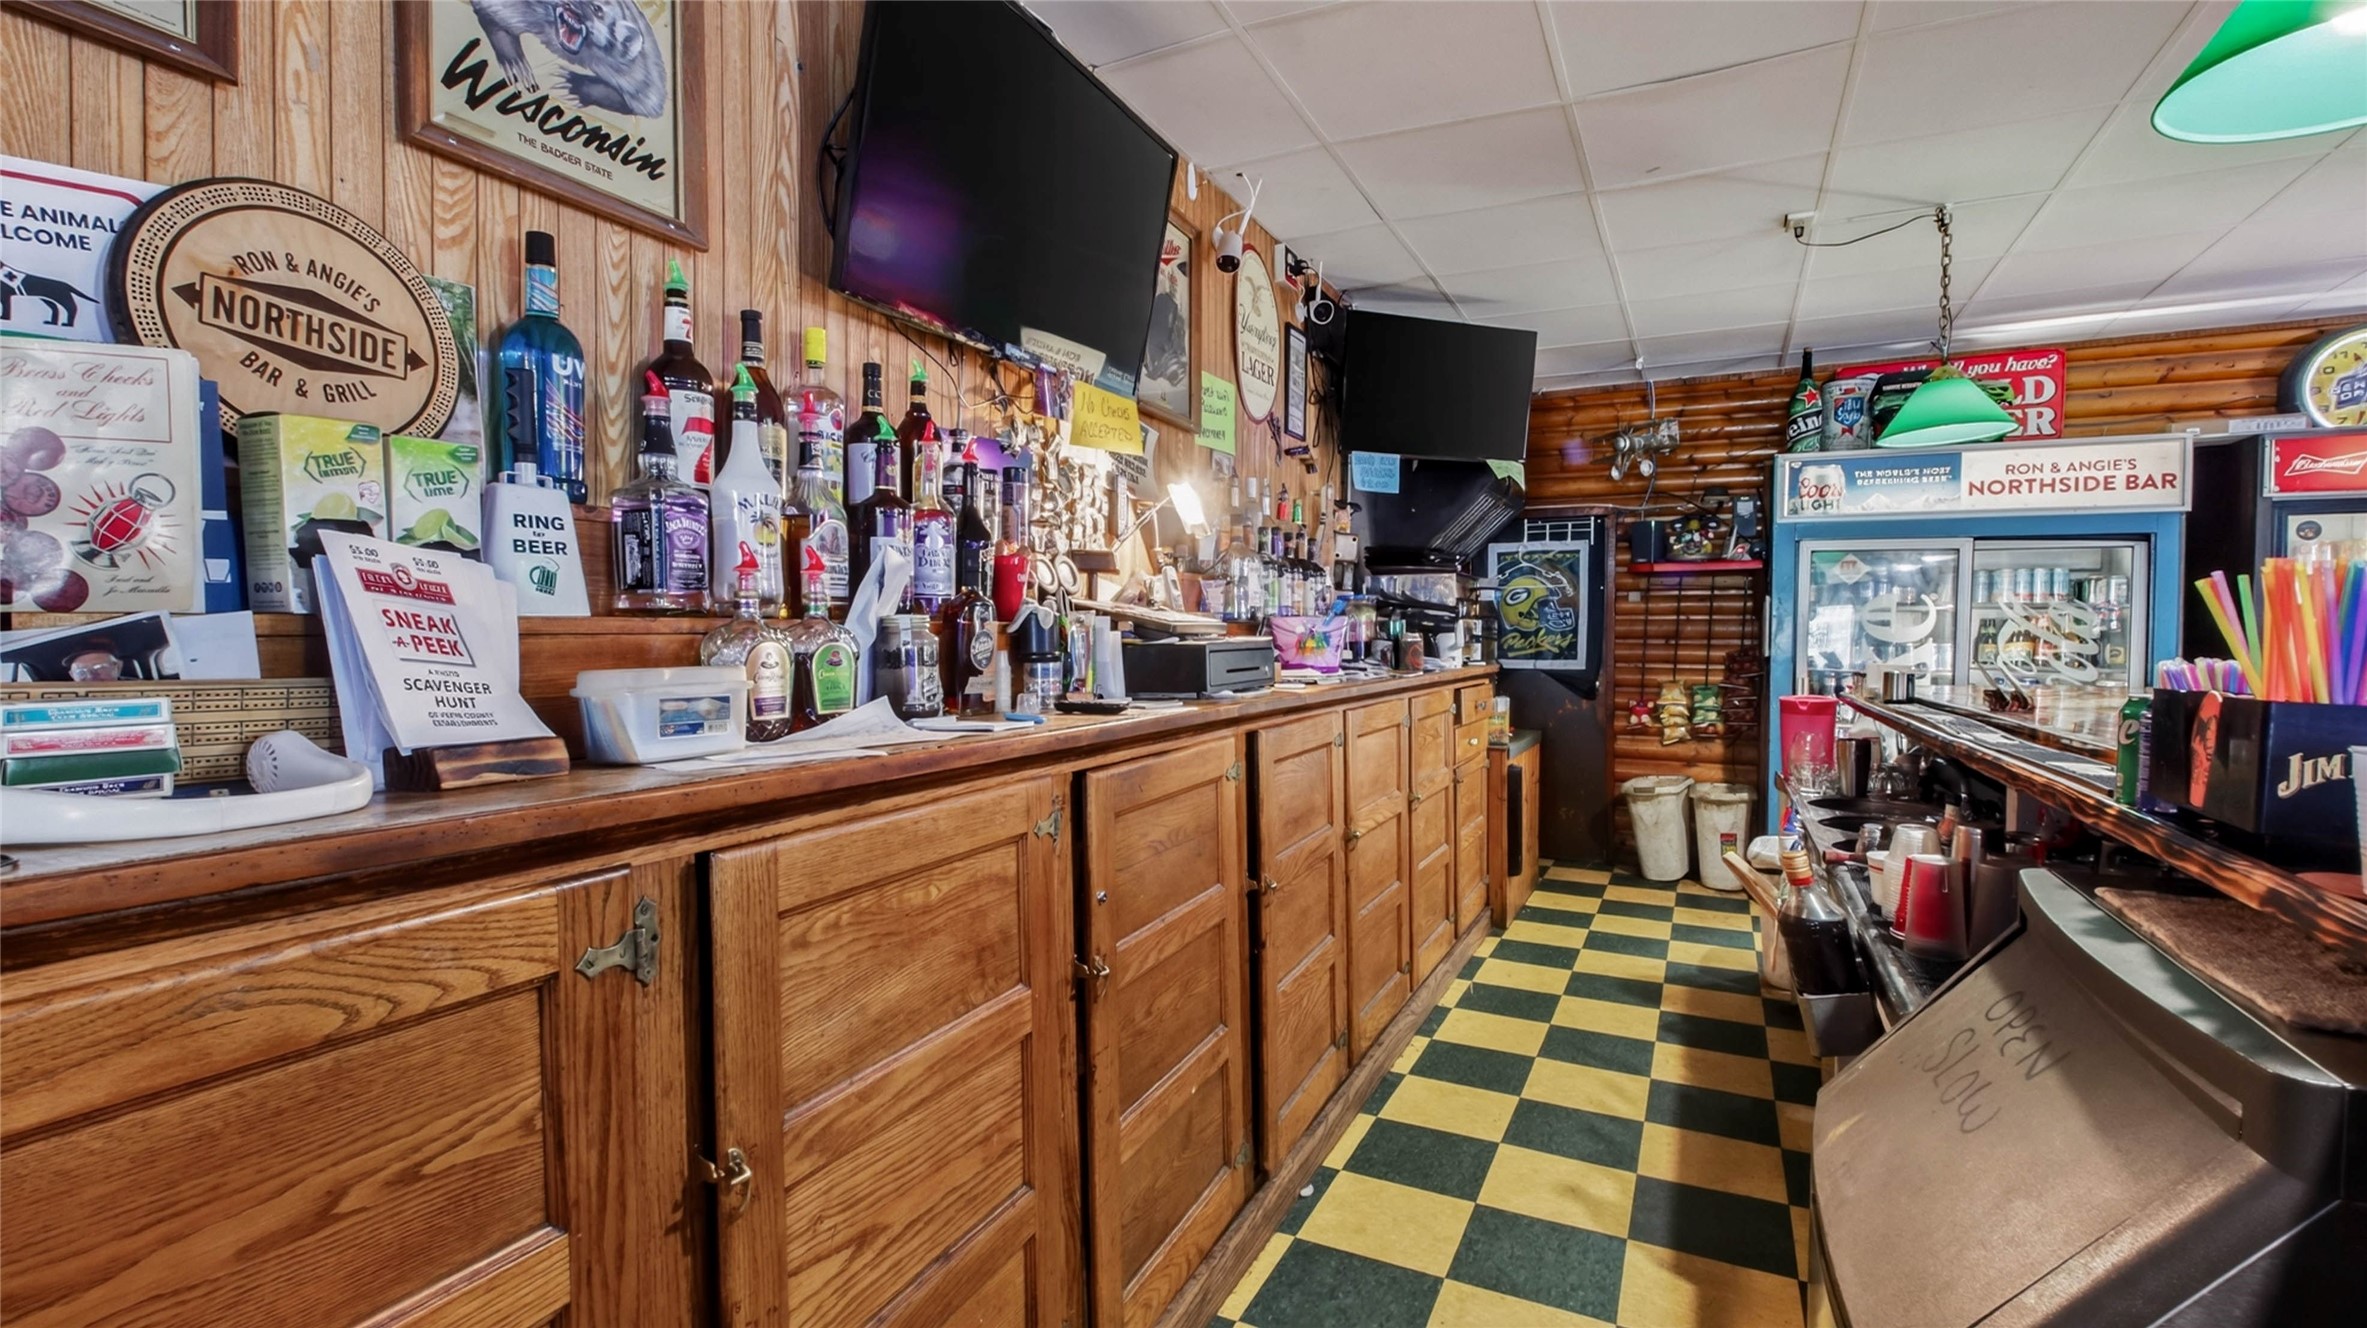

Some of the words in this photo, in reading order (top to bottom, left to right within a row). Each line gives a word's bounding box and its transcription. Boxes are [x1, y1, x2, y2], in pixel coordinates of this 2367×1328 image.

[441, 38, 667, 181] Wisconsin
[517, 132, 537, 150] THE
[541, 142, 582, 168] BADGER
[585, 161, 613, 181] STATE
[232, 250, 279, 276] RON
[285, 252, 300, 273] &
[307, 259, 381, 313] ANGIE'S
[212, 285, 397, 370] NORTHSIDE
[239, 351, 283, 387] BAR
[295, 378, 309, 399] &
[323, 380, 377, 403] GRILL
[1242, 351, 1274, 387] LAGER
[1967, 363, 2001, 377] you
[2005, 354, 2058, 372] have?
[56, 385, 97, 399] and
[71, 400, 145, 427] Lights
[311, 451, 355, 468] TRUE
[2005, 463, 2044, 475] RON
[2050, 462, 2061, 473] &
[2066, 458, 2137, 472] ANGIE'S
[412, 470, 458, 487] TRUE
[1855, 470, 1873, 478] THE
[1968, 475, 2117, 496] NORTHSIDE
[2125, 473, 2177, 491] BAR
[423, 485, 455, 498] lime
[513, 513, 565, 531] RING
[513, 539, 568, 556] BEER
[382, 608, 457, 635] SNEAK
[410, 634, 464, 657] PEEK
[1501, 628, 1577, 654] Packers
[403, 677, 492, 695] SCAVENGER
[435, 695, 476, 709] HUNT
[2277, 752, 2348, 799] JIM
[1985, 990, 2072, 1080] OPEN
[1922, 1028, 2002, 1134] SLOW
